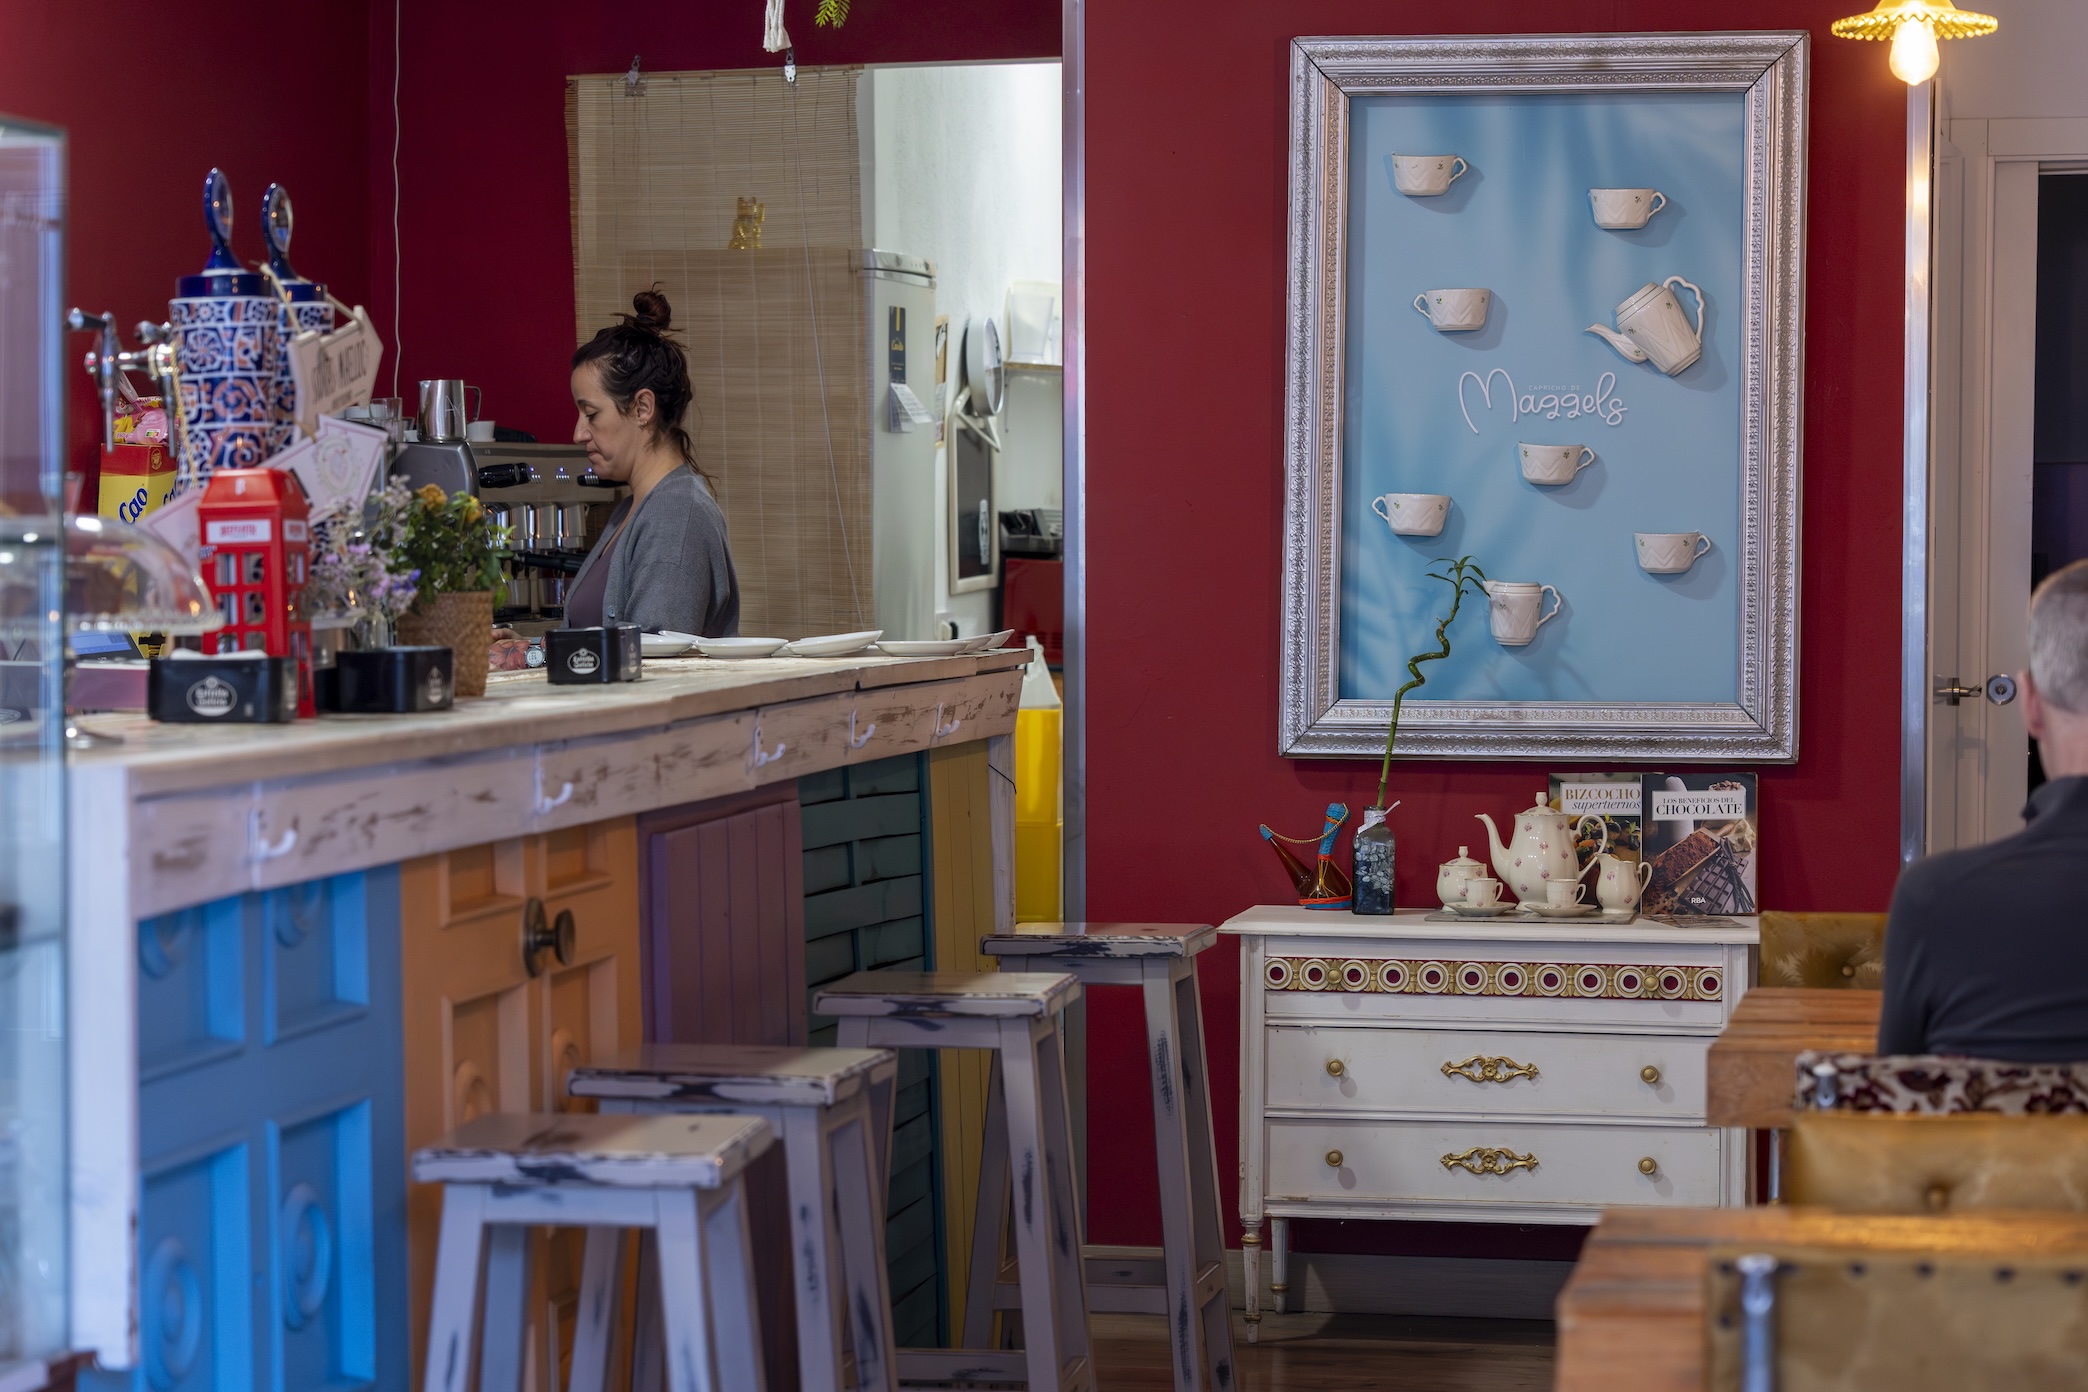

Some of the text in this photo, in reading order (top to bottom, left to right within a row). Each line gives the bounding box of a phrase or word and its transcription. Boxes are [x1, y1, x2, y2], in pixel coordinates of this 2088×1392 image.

[1458, 368, 1628, 434] Maggels
[118, 487, 148, 524] Cao
[1565, 788, 1641, 800] BIZCOCHO
[1571, 800, 1642, 813] supertiernos
[1656, 803, 1743, 815] CHOCOLATE
